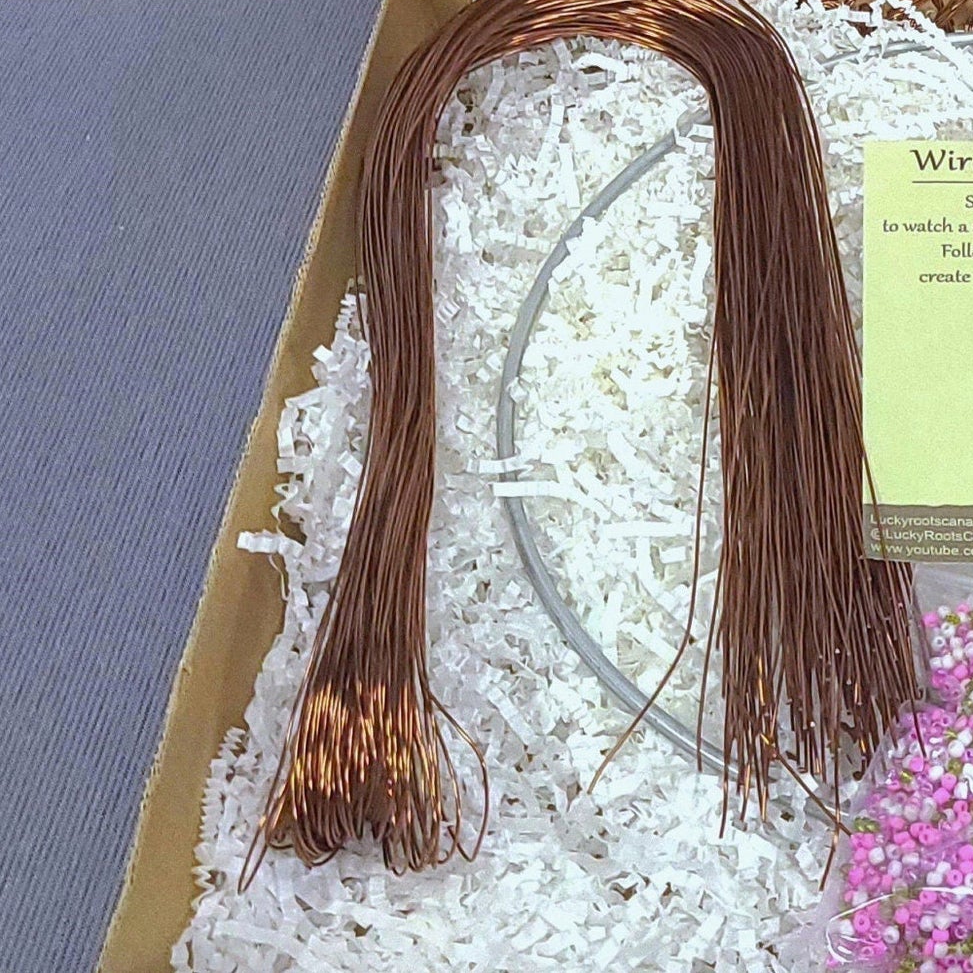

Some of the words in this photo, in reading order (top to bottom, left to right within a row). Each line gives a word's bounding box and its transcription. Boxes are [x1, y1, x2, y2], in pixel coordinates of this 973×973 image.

[883, 219, 899, 233] to
[903, 217, 953, 234] watch
[958, 222, 967, 233] a
[919, 269, 971, 284] create
